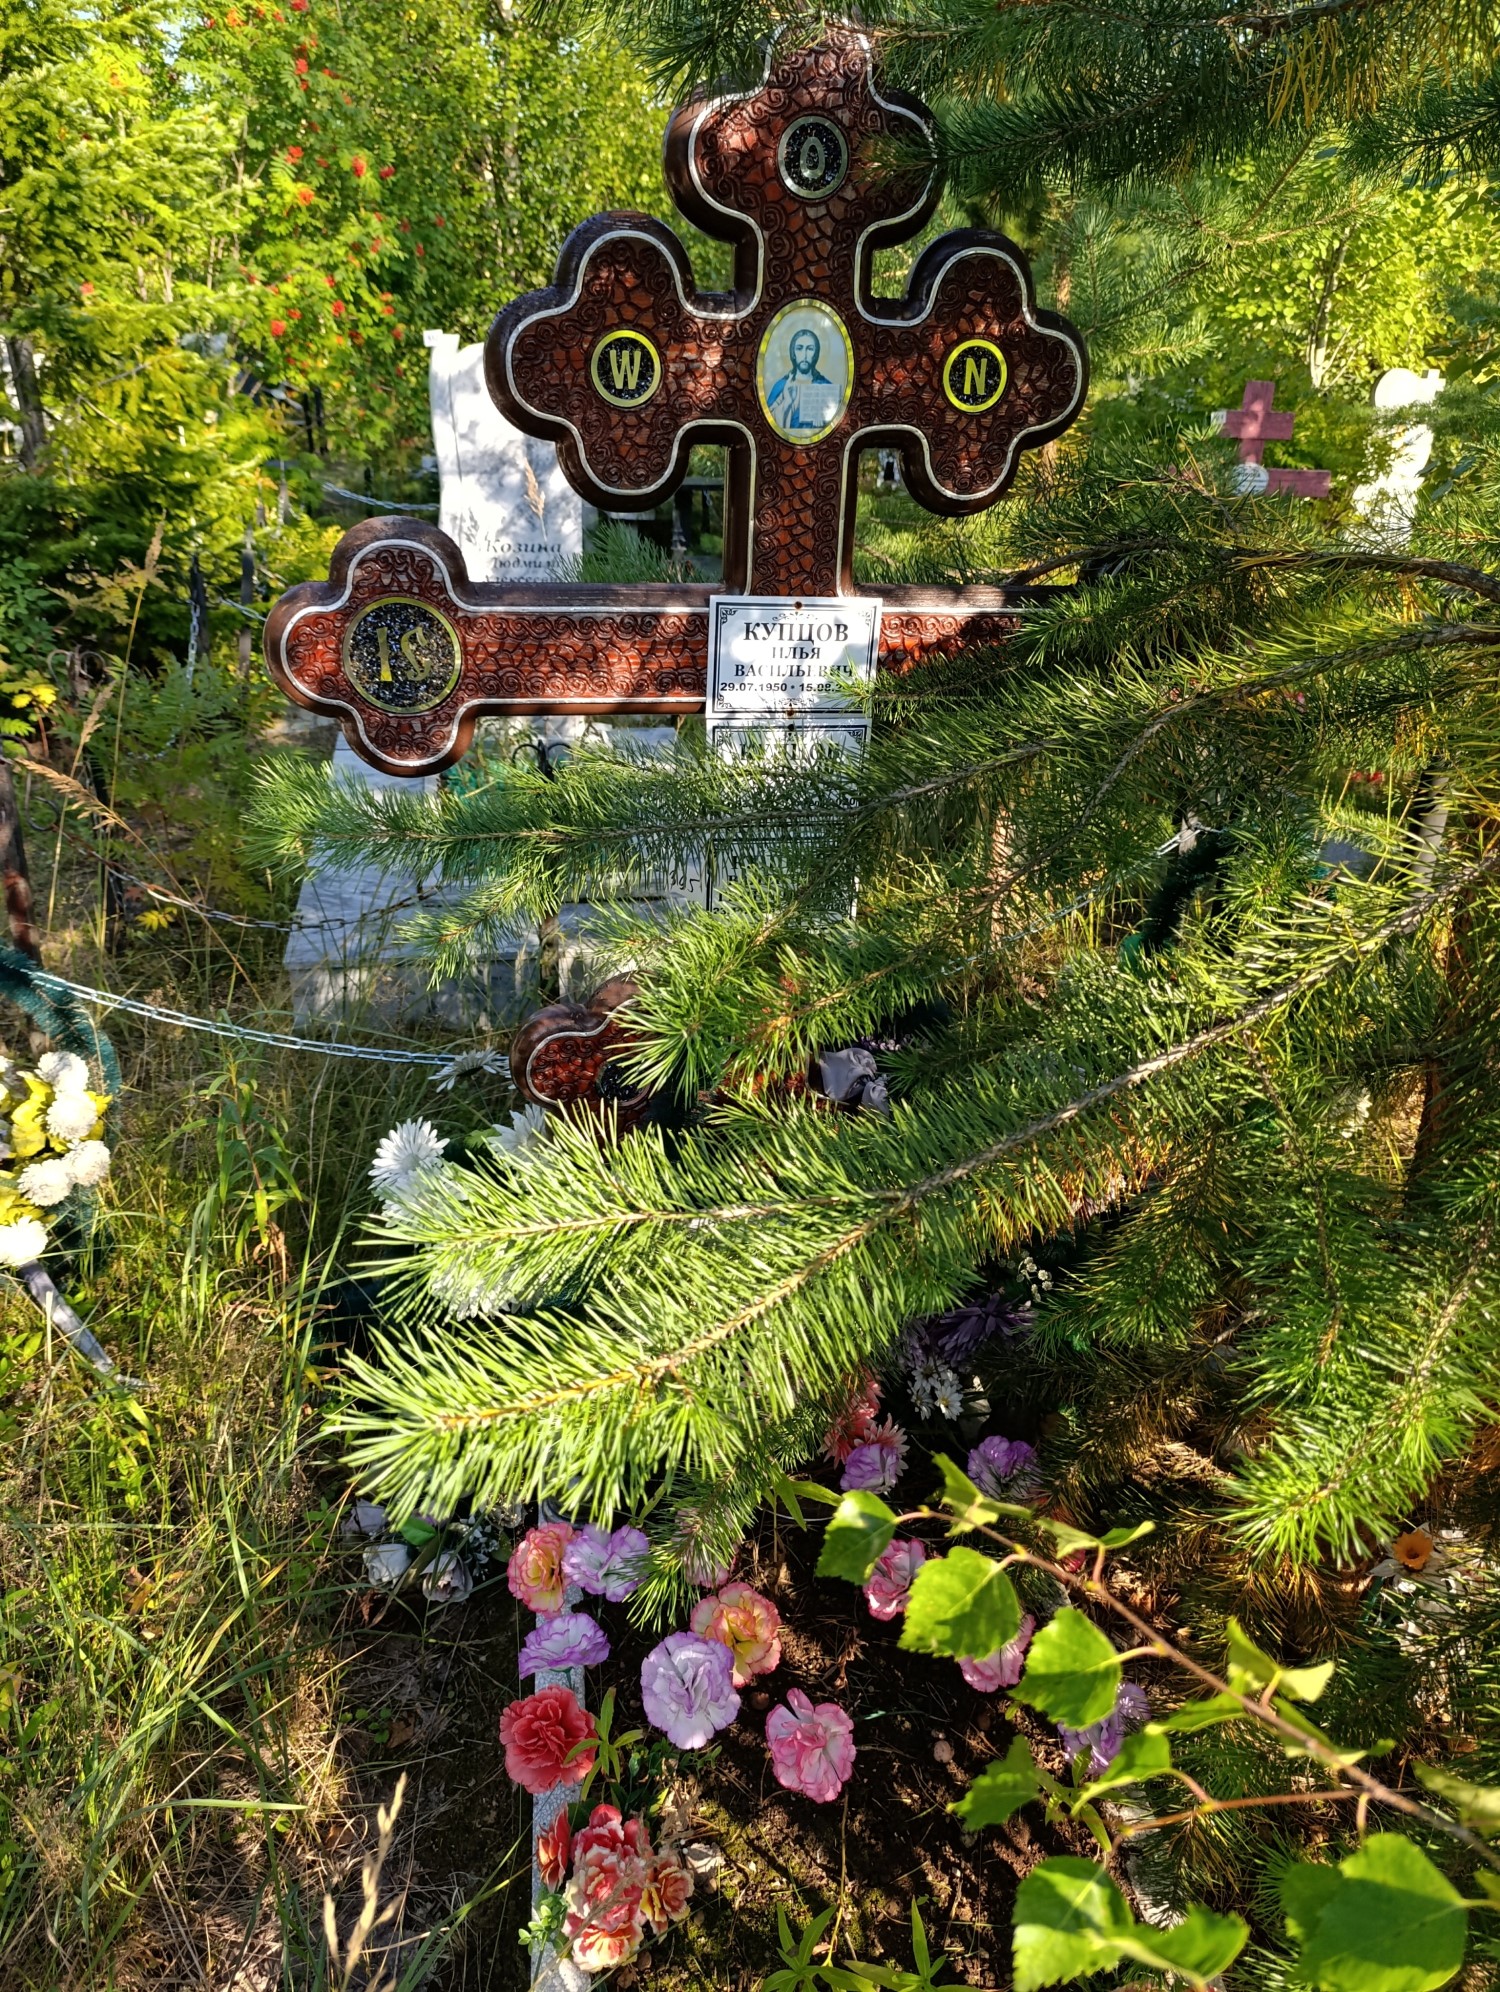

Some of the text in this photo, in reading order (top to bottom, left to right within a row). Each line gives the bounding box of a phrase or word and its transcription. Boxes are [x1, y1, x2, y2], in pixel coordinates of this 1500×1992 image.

[609, 349, 642, 390] W
[963, 358, 988, 395] N
[743, 622, 849, 645] КУПЦОВ
[772, 646, 821, 660] ИЛЬЯ
[720, 682, 788, 692] 29.07.1950
